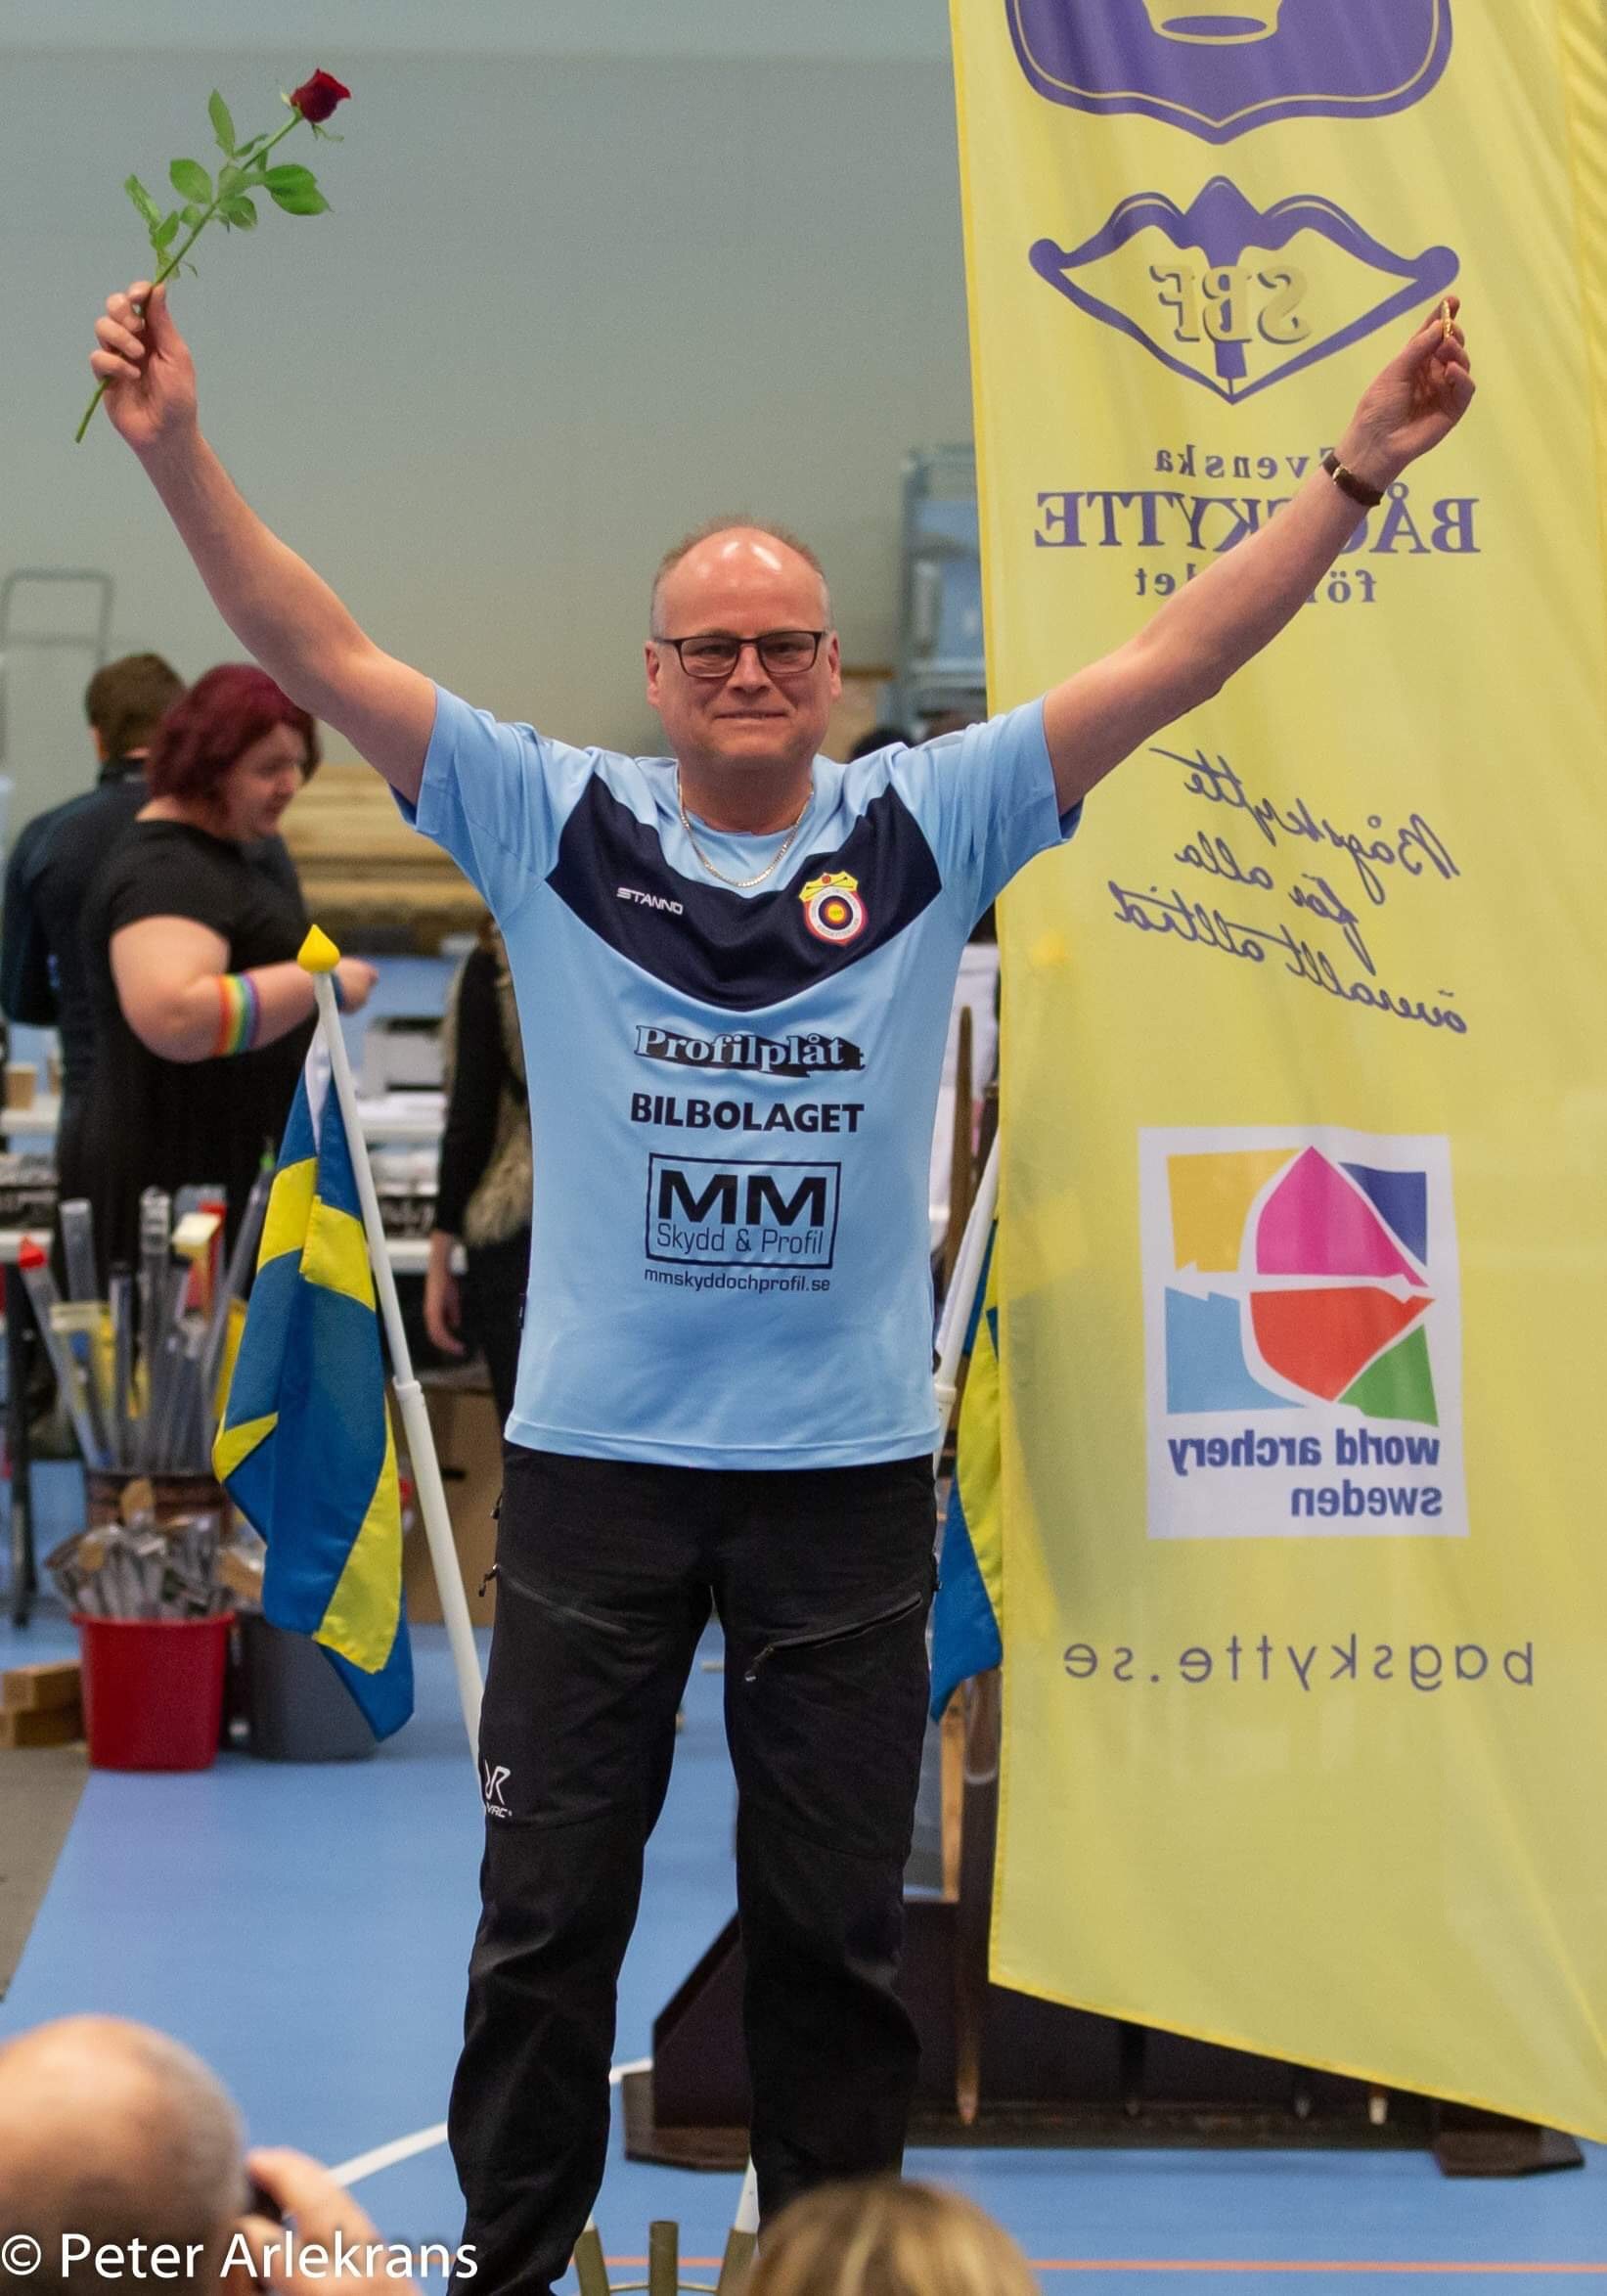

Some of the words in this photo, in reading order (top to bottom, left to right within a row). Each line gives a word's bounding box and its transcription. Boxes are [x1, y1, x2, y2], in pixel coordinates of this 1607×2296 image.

[616, 886, 684, 916] STANNO
[634, 1025, 859, 1076] Profilplåt
[631, 1093, 865, 1132] BILBOLAGET
[658, 1169, 827, 1227] MM
[657, 1223, 725, 1253] Skydd
[736, 1229, 751, 1251] &
[761, 1229, 824, 1255] Profil
[644, 1267, 830, 1293] mmskyddochprofil.se
